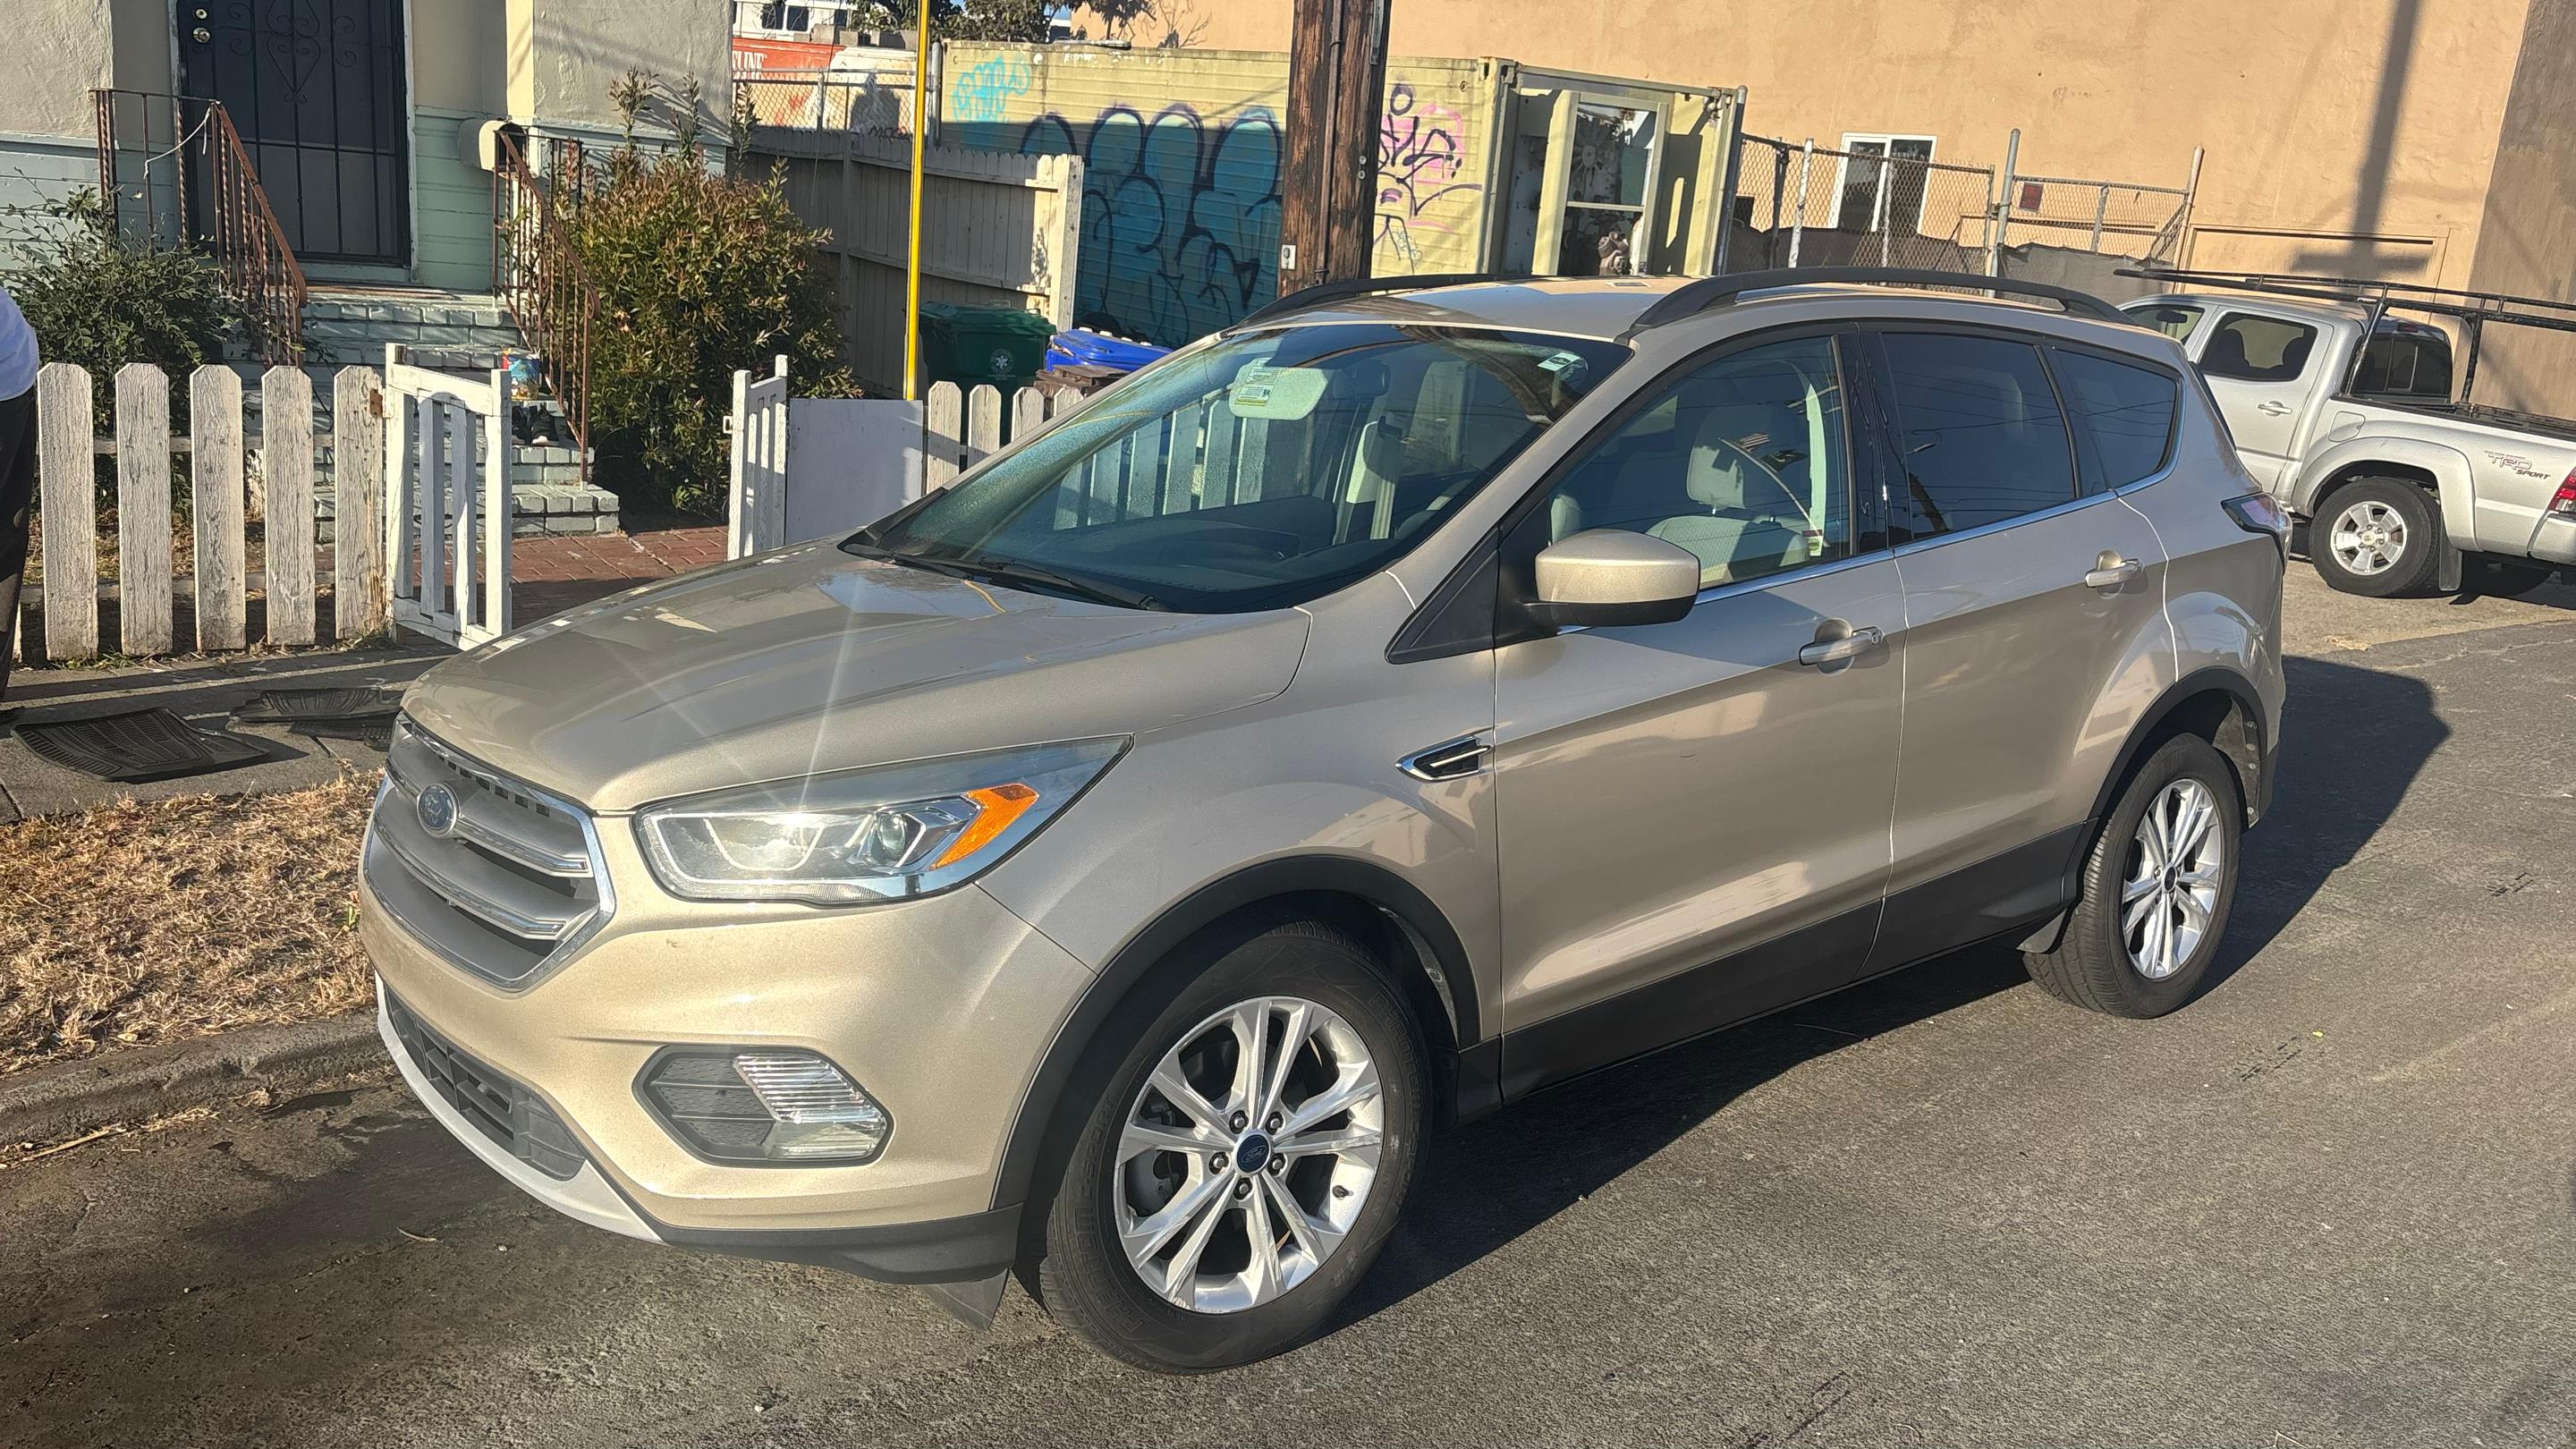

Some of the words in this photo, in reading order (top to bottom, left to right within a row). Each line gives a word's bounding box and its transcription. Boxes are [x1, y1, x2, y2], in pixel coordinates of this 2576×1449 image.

[2487, 453, 2532, 470] TRD
[2515, 469, 2551, 480] SPORT
[1073, 1206, 1145, 1336] PHANTOM
